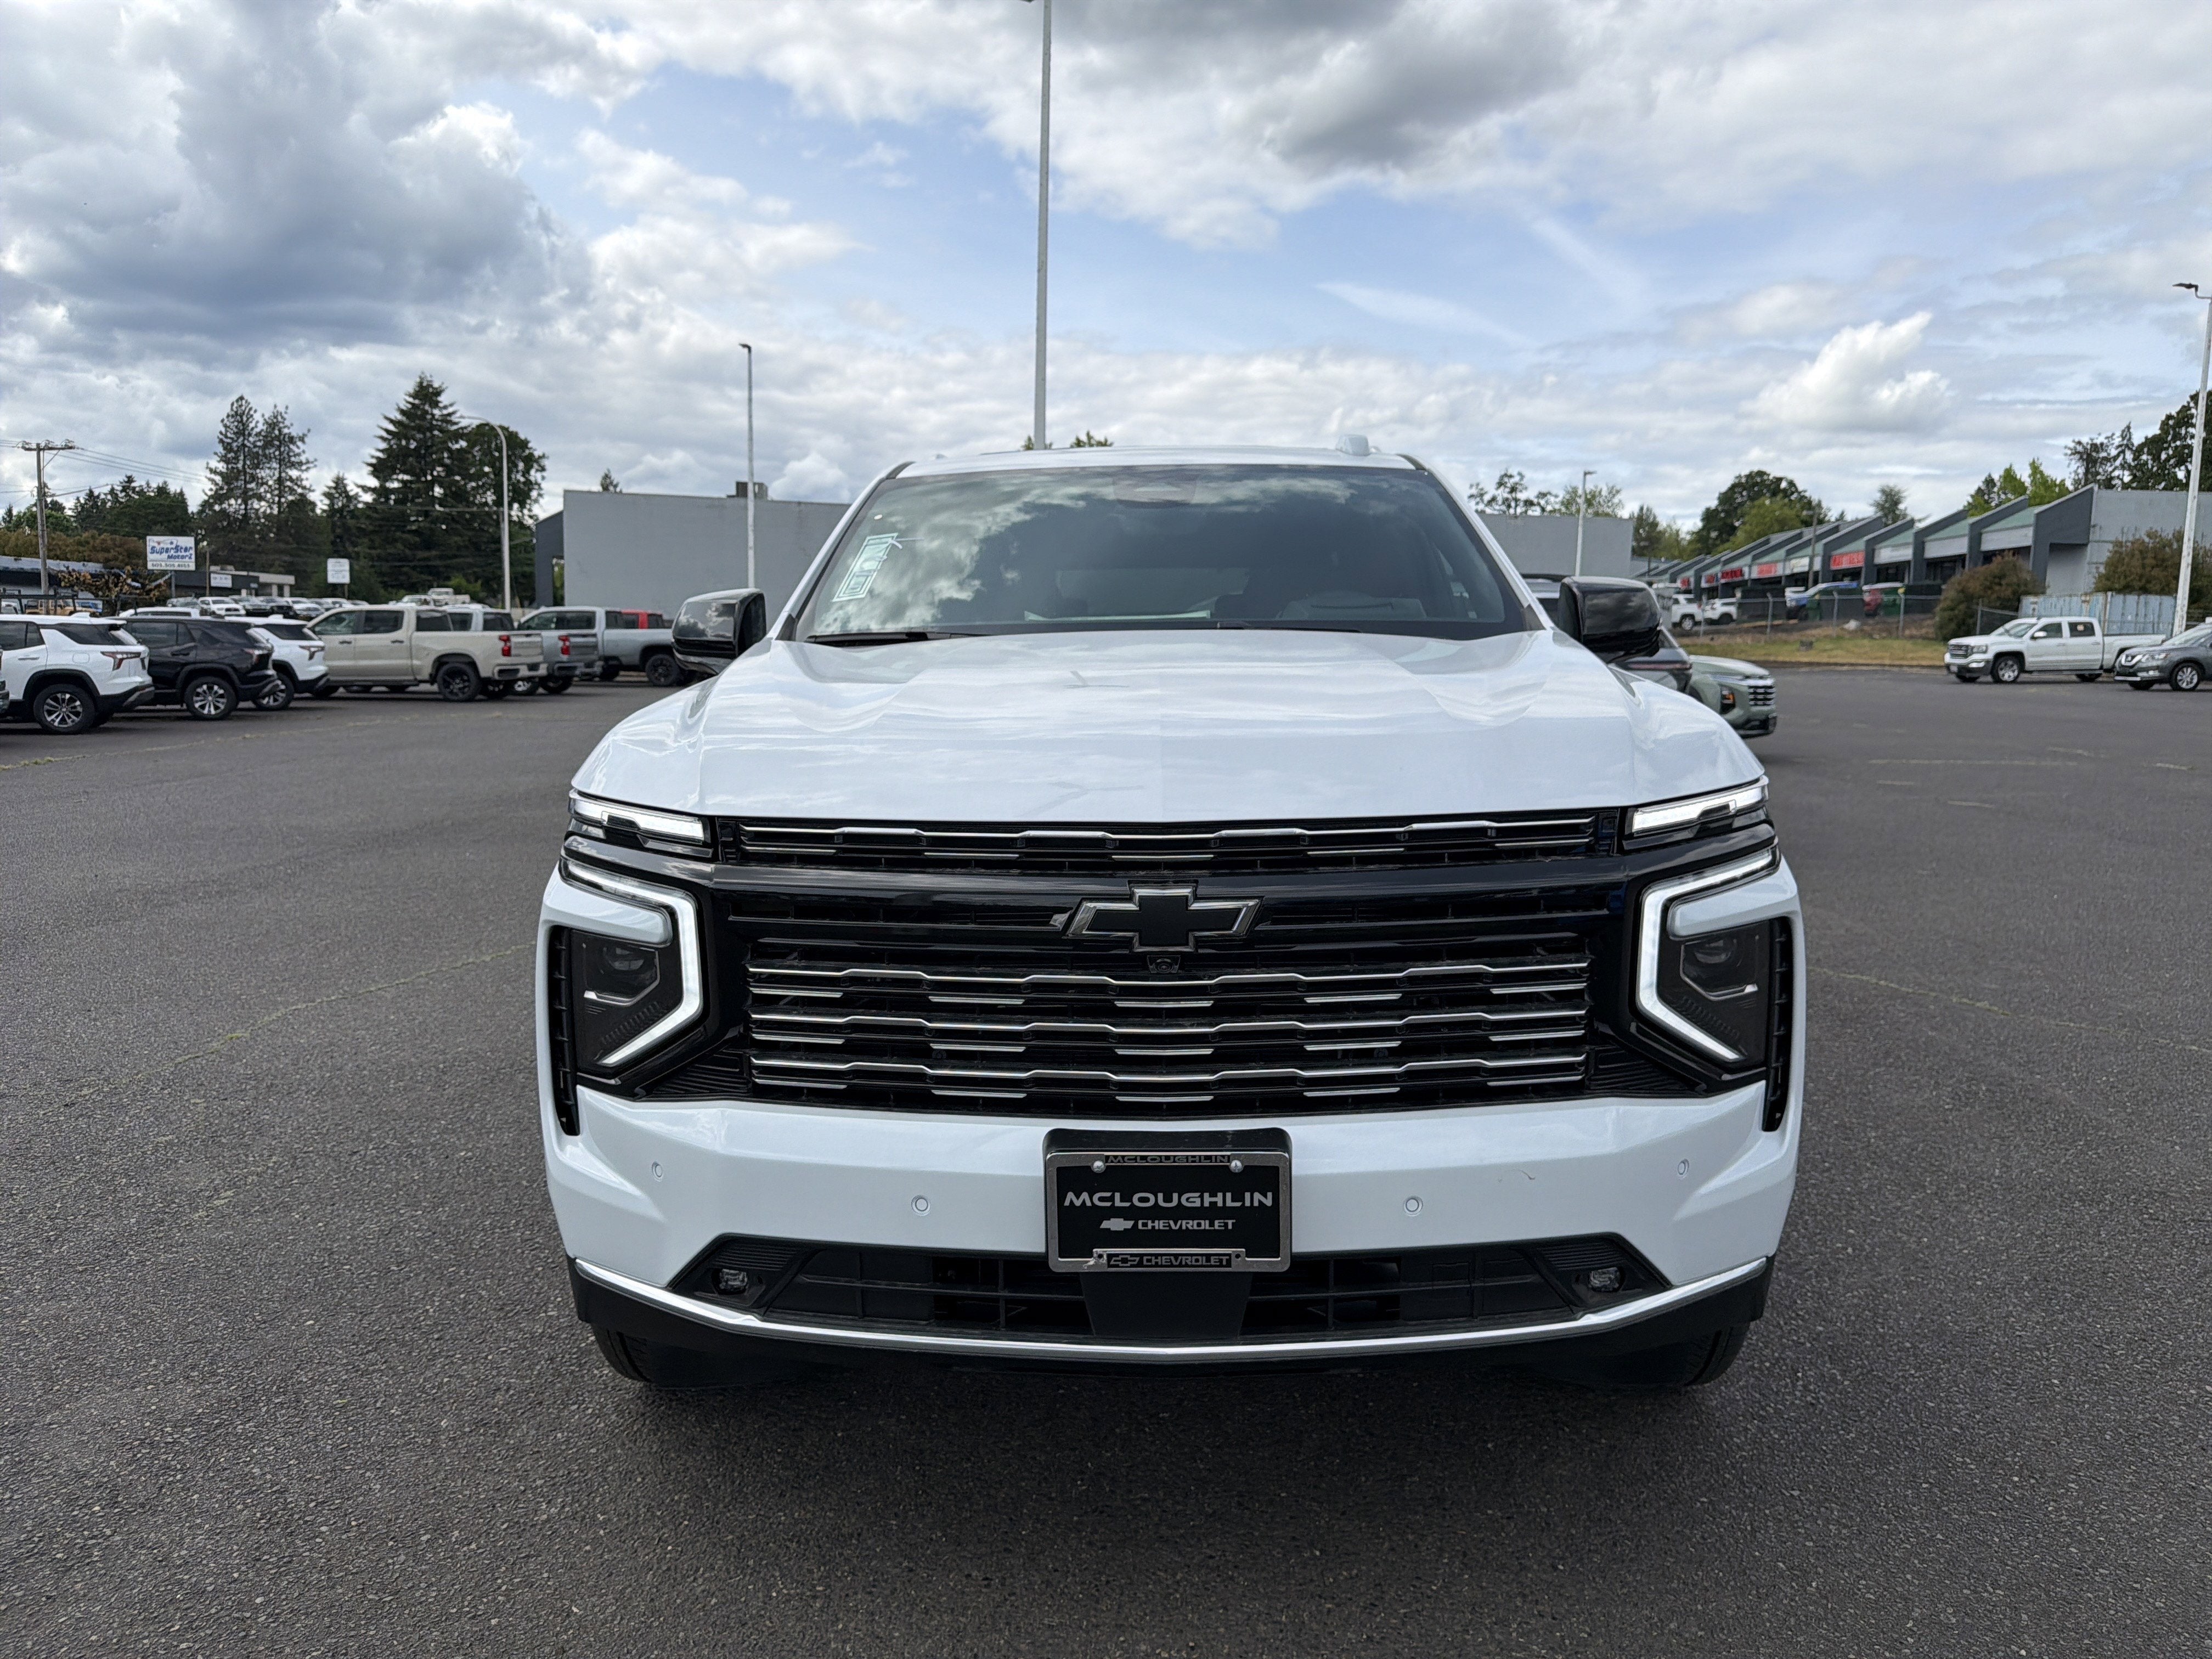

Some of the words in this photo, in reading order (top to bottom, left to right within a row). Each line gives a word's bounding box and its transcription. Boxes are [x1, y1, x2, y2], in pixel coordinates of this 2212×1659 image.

[1107, 1155, 1229, 1164] MCLOUGHLIN
[1064, 1192, 1273, 1207] MCLOUGHLIN
[1138, 1220, 1236, 1230] CHEVROLET
[1143, 1256, 1230, 1266] CHEVROLET
